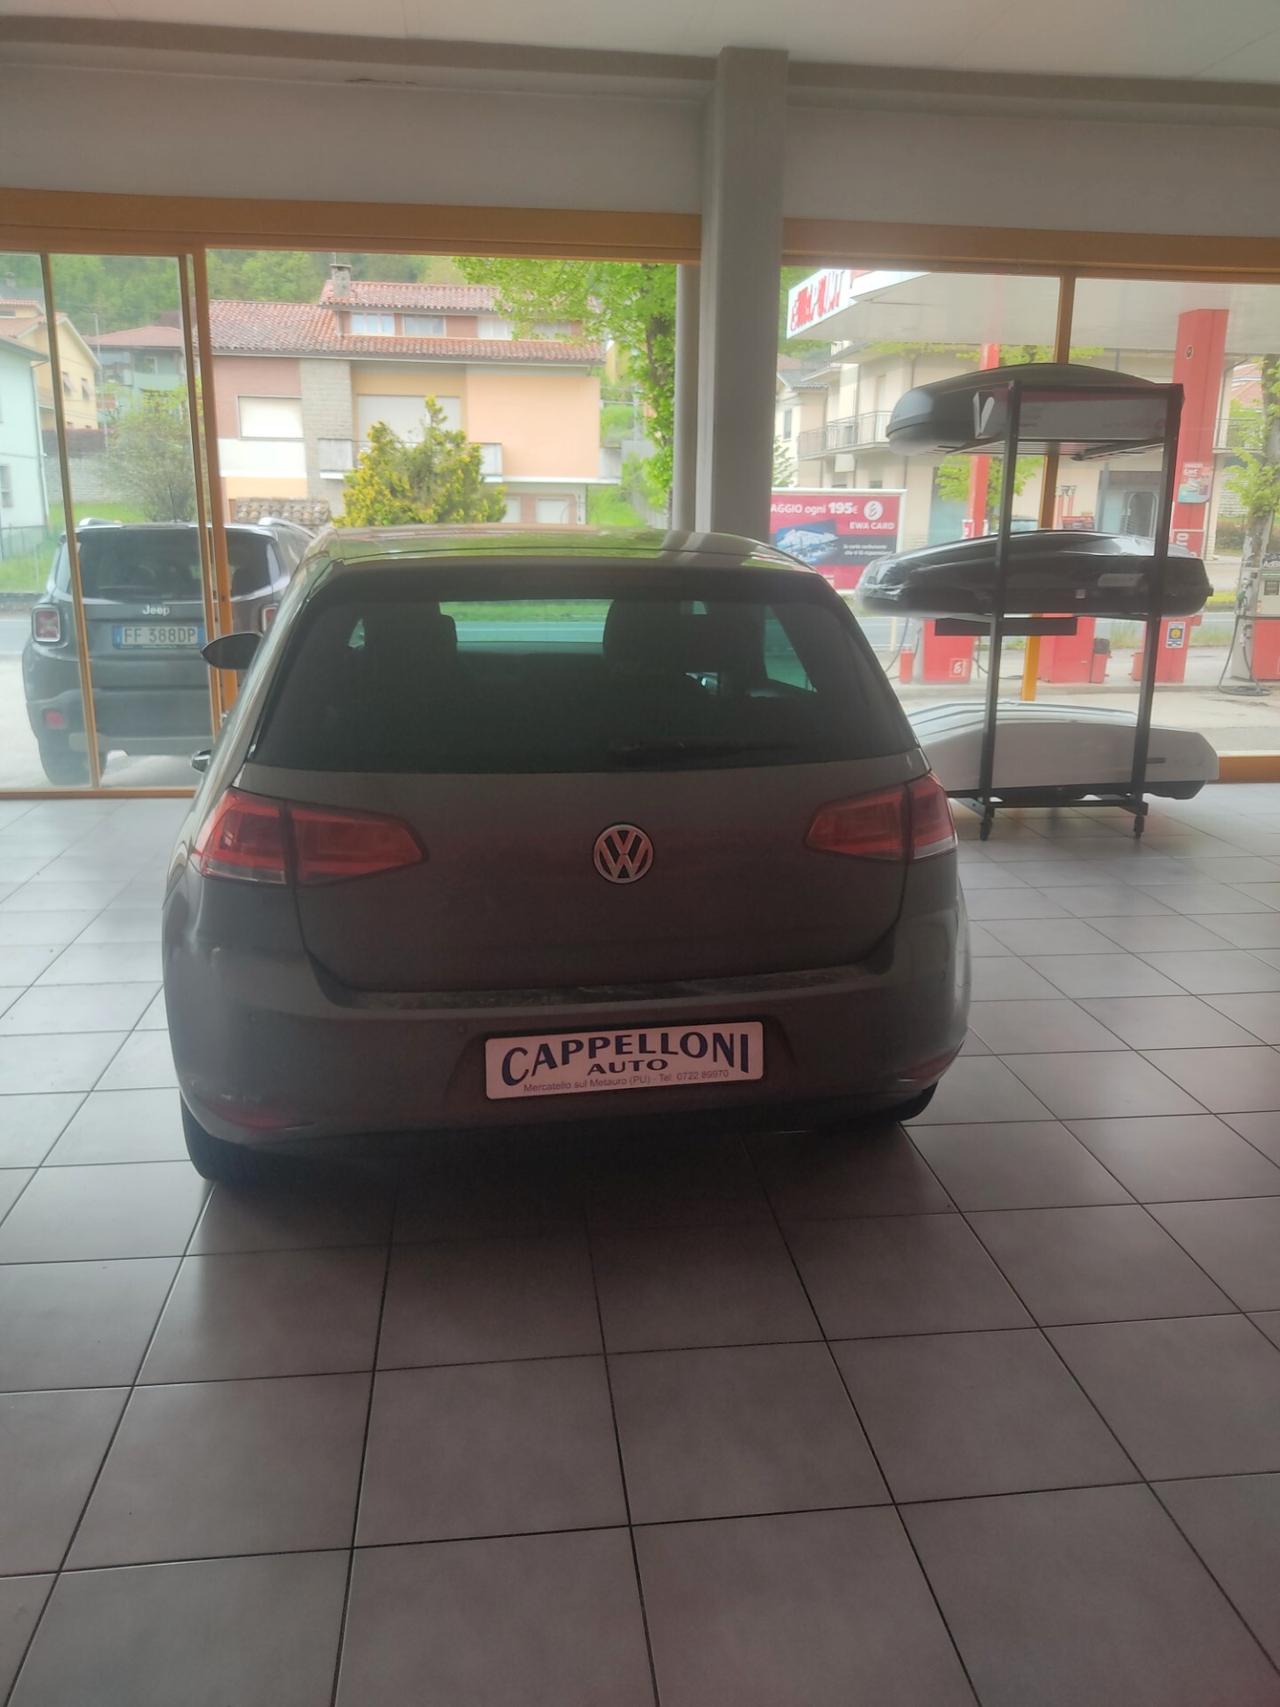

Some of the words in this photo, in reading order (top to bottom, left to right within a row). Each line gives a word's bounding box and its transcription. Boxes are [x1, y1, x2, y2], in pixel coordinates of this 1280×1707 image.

[770, 503, 803, 514] AGGIO
[804, 504, 826, 516] ogni
[849, 521, 869, 530] EWA
[870, 521, 895, 530] CARD
[142, 604, 170, 616] Jeep
[124, 628, 142, 644] FF
[501, 1031, 749, 1087] CAPPELLONI
[587, 1058, 668, 1077] AUTO
[574, 1079, 587, 1090] sul
